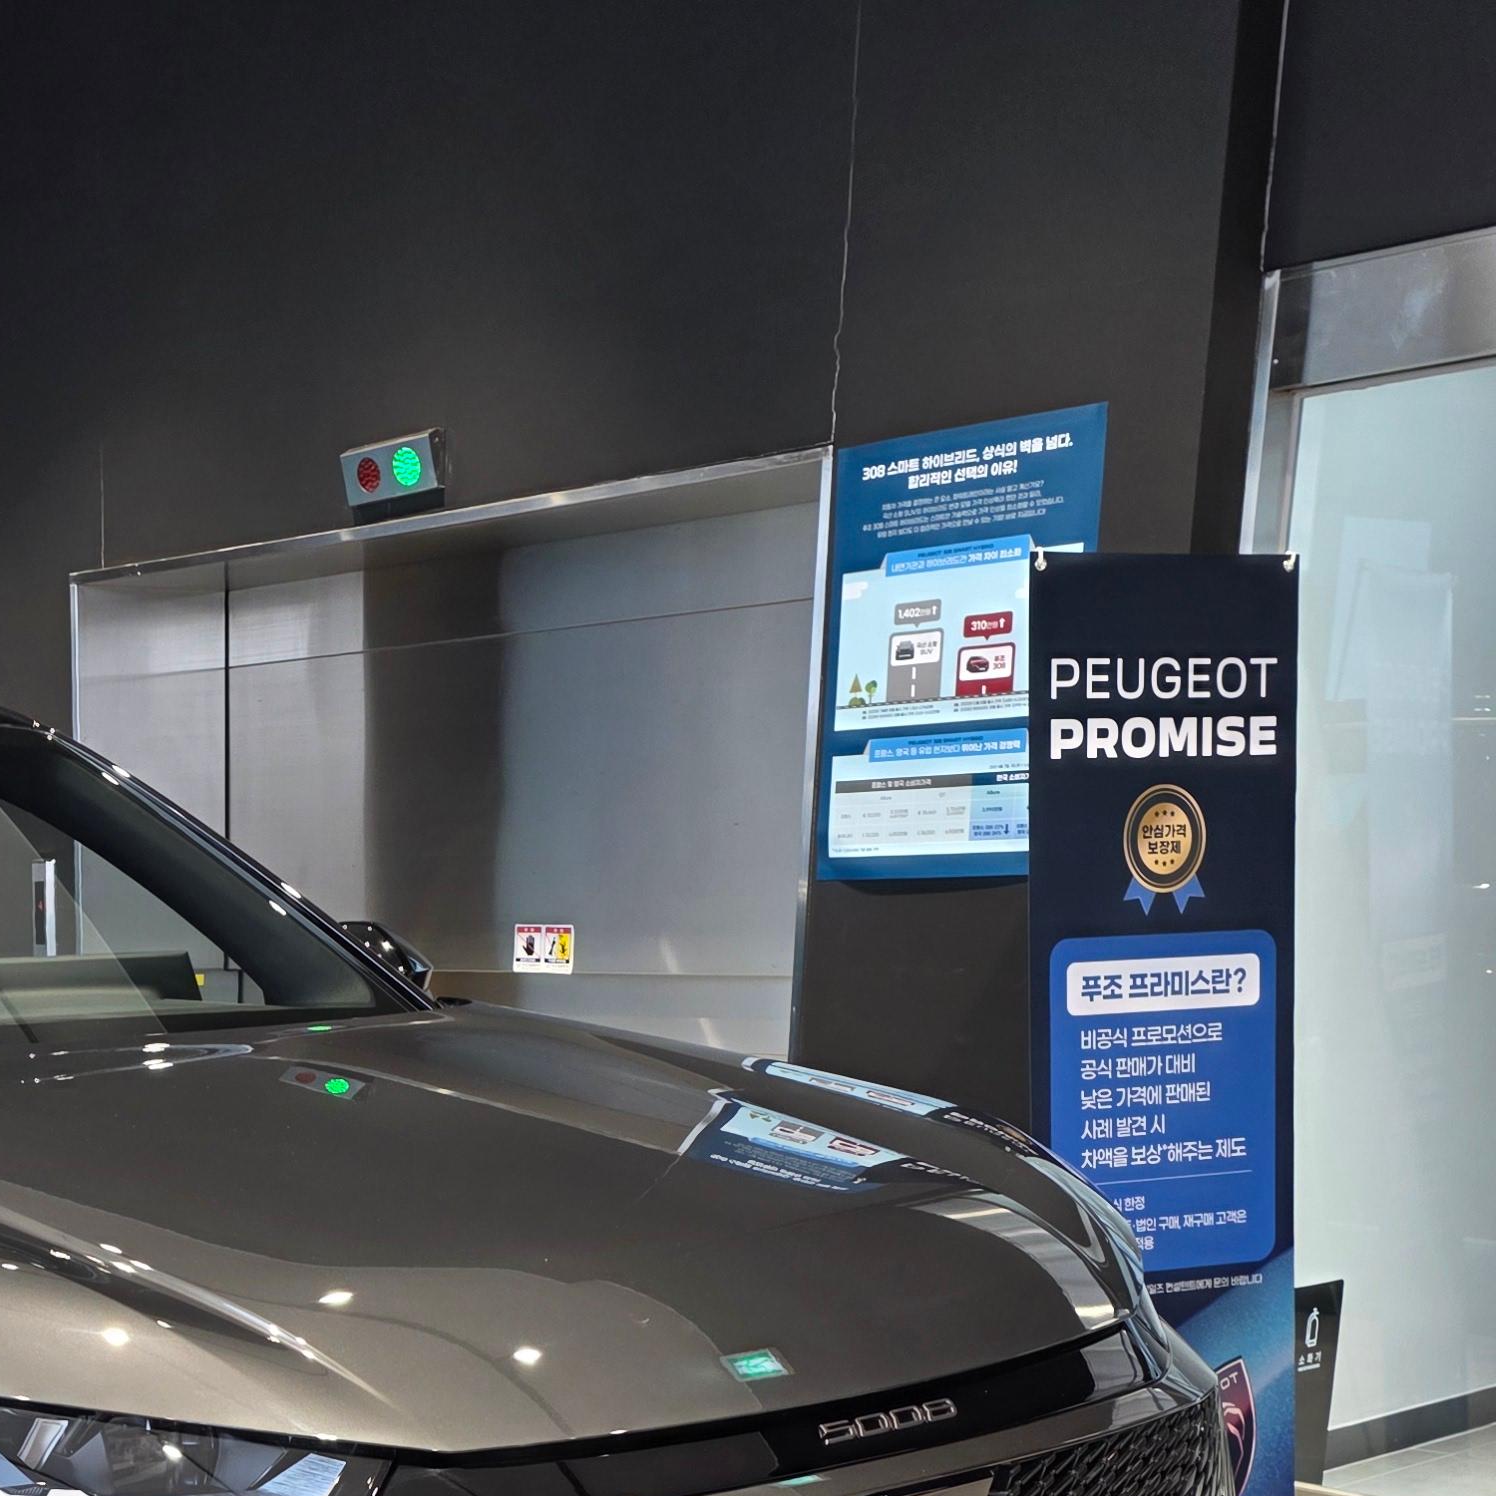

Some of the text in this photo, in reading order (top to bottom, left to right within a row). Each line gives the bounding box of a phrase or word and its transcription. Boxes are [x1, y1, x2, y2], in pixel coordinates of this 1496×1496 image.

[862, 464, 886, 481] 308
[887, 458, 920, 476] 스마트
[922, 448, 980, 469] 하이브리드,
[982, 442, 1017, 460] 상식의
[954, 463, 988, 482] 선택의
[990, 459, 1018, 476] 이유!
[1050, 656, 1279, 700] PEUGEOT
[1050, 715, 1278, 760] PROMISE
[1142, 823, 1187, 839] 안심가격
[1147, 840, 1182, 855] 보장제
[1081, 966, 1247, 1002] 푸조 프라미스란?
[1080, 1022, 1223, 1050] 비공식 프로모션으로
[1080, 1052, 1196, 1080] 공식 판매가 대비
[1080, 1081, 1211, 1110] 낮은 가격에 판매된
[1080, 1113, 1166, 1140] 사례 발견 시
[1080, 1146, 1129, 1169] 차액을
[1215, 1137, 1248, 1158] 제도
[1124, 1195, 1146, 1211] 한정
[1183, 1211, 1215, 1228] 재구매
[1215, 1209, 1248, 1225] 고객은
[818, 1397, 958, 1446] 5008
